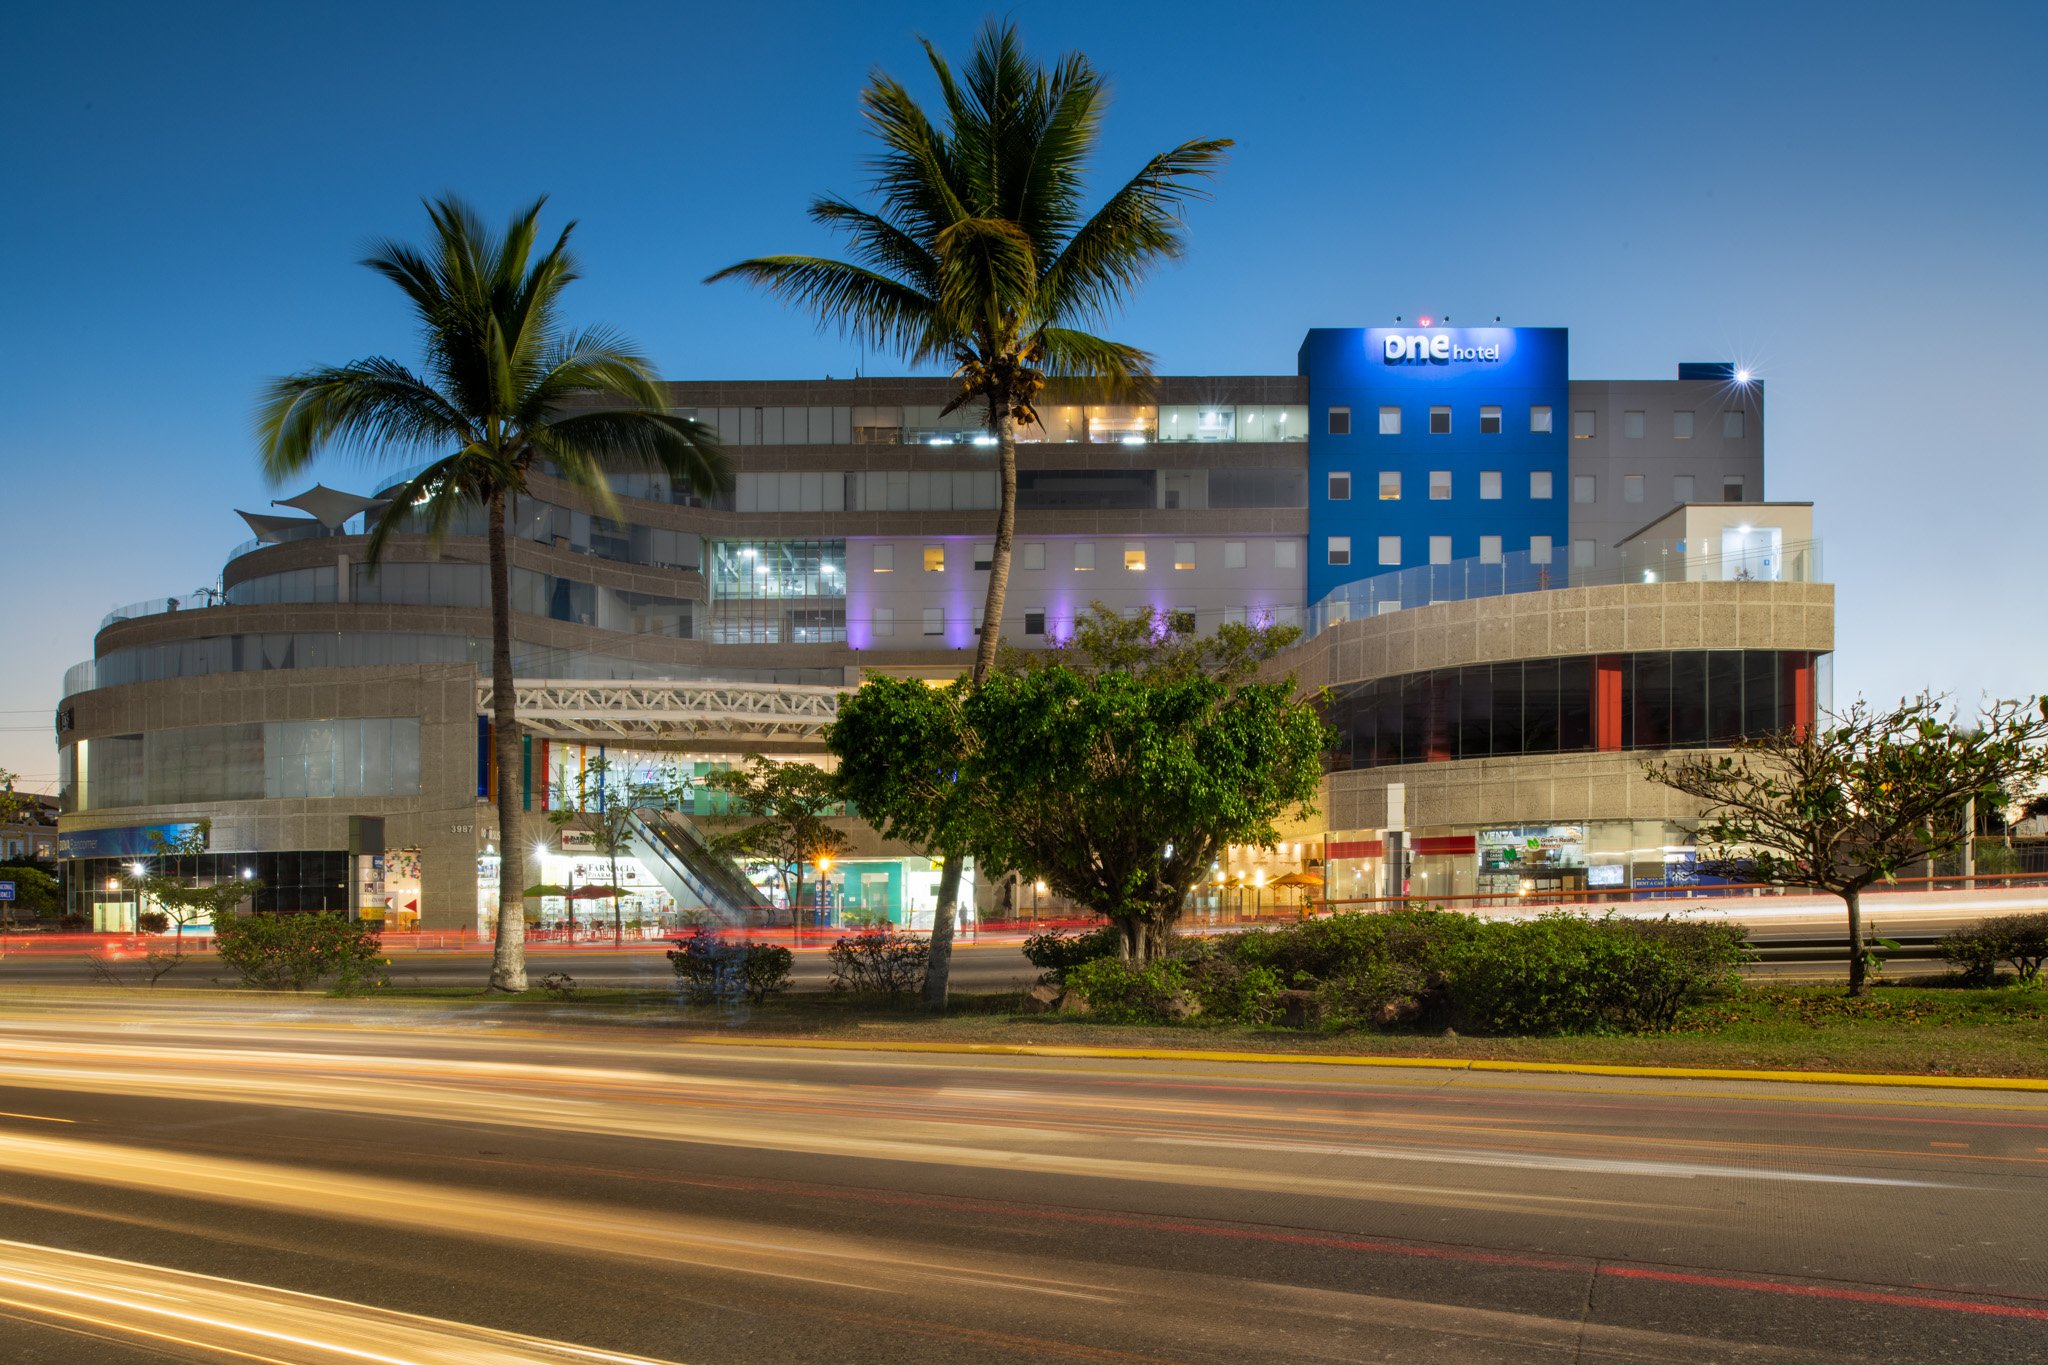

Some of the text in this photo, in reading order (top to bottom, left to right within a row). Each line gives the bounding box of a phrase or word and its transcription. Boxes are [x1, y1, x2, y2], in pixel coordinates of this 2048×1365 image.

[1384, 334, 1499, 363] one hotel
[451, 824, 473, 834] 3987
[1482, 830, 1515, 841] VENTA
